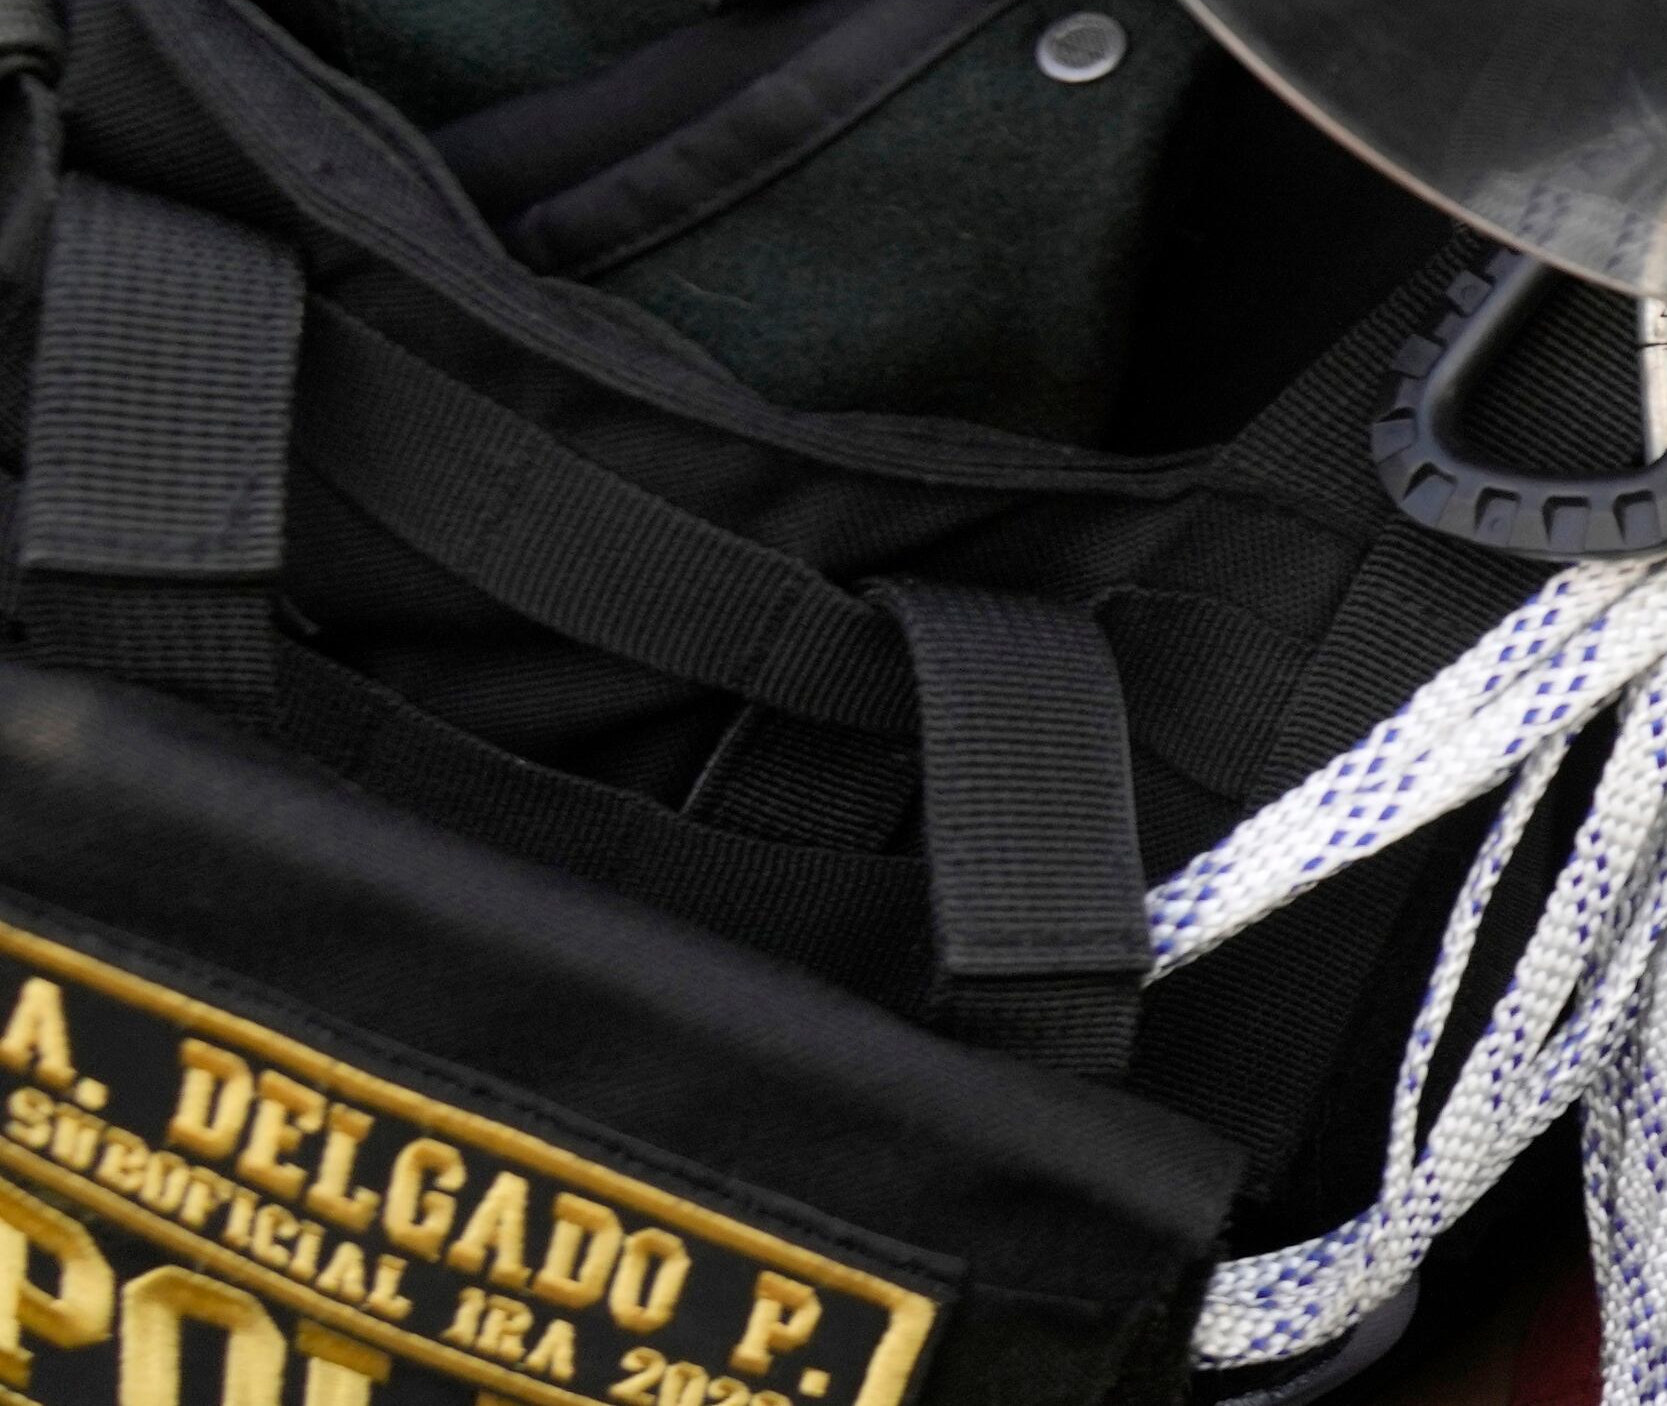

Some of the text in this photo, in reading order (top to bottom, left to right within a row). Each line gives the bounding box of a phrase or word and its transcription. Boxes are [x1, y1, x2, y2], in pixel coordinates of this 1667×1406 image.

[0, 975, 831, 1398] A. DELGADO P.
[5, 1085, 413, 1320] SUBOFICIAL
